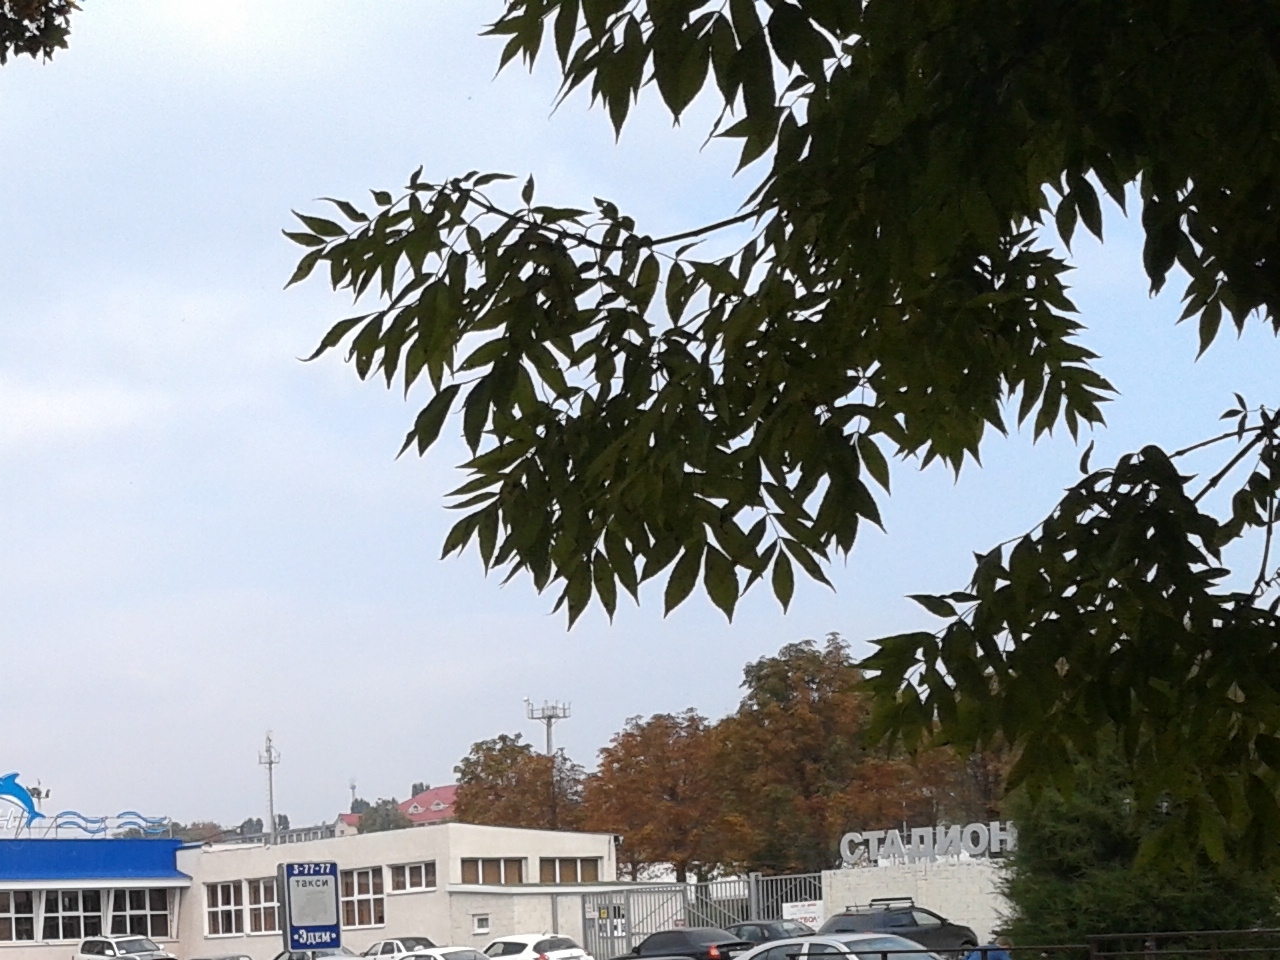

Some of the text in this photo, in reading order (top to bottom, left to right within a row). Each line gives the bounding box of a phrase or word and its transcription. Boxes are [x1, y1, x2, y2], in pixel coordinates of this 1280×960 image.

[840, 821, 1016, 864] СТАДИОН
[293, 864, 331, 874] 3-77-77
[295, 879, 329, 888] такси
